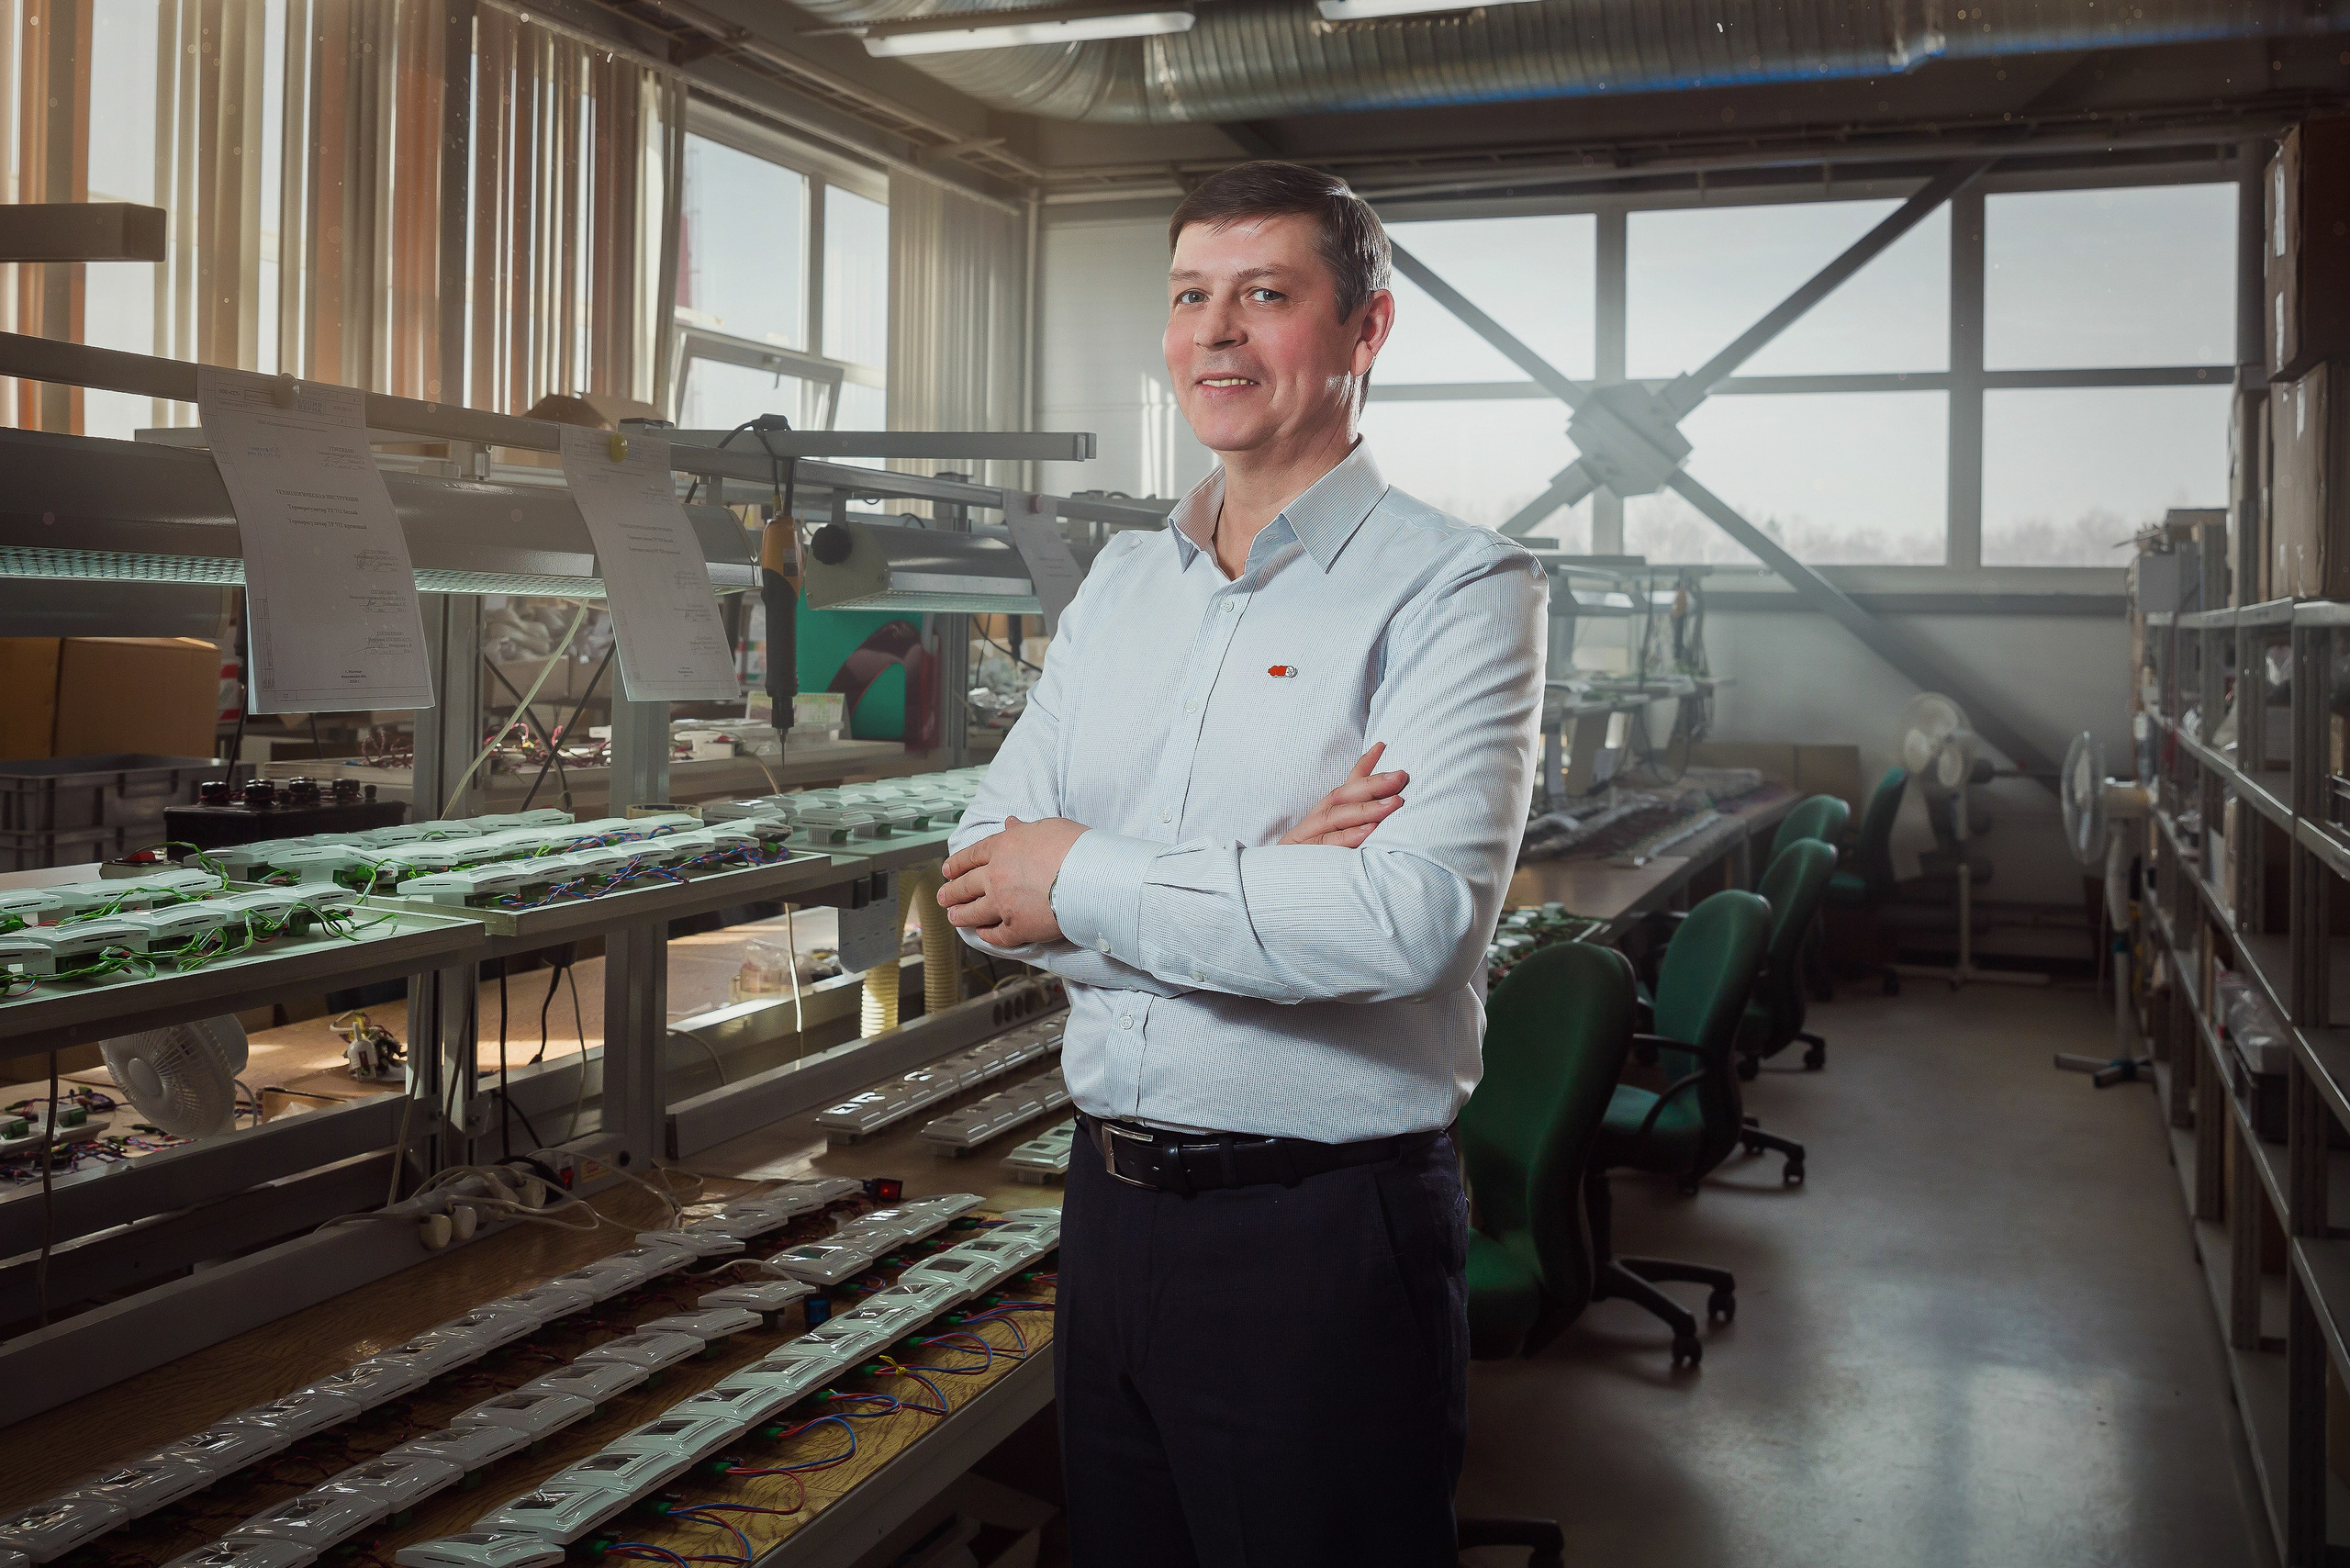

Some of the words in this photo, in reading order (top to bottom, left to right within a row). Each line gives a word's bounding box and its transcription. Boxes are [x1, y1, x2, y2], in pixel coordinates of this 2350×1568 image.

[297, 398, 322, 409] КОПИЯ
[297, 404, 322, 414] ВЕРНА
[275, 488, 326, 498] ТЕХНОЛОГИЧЕСКАЯ
[287, 503, 326, 513] Терморегулятор
[288, 518, 327, 527] Терморегулятор
